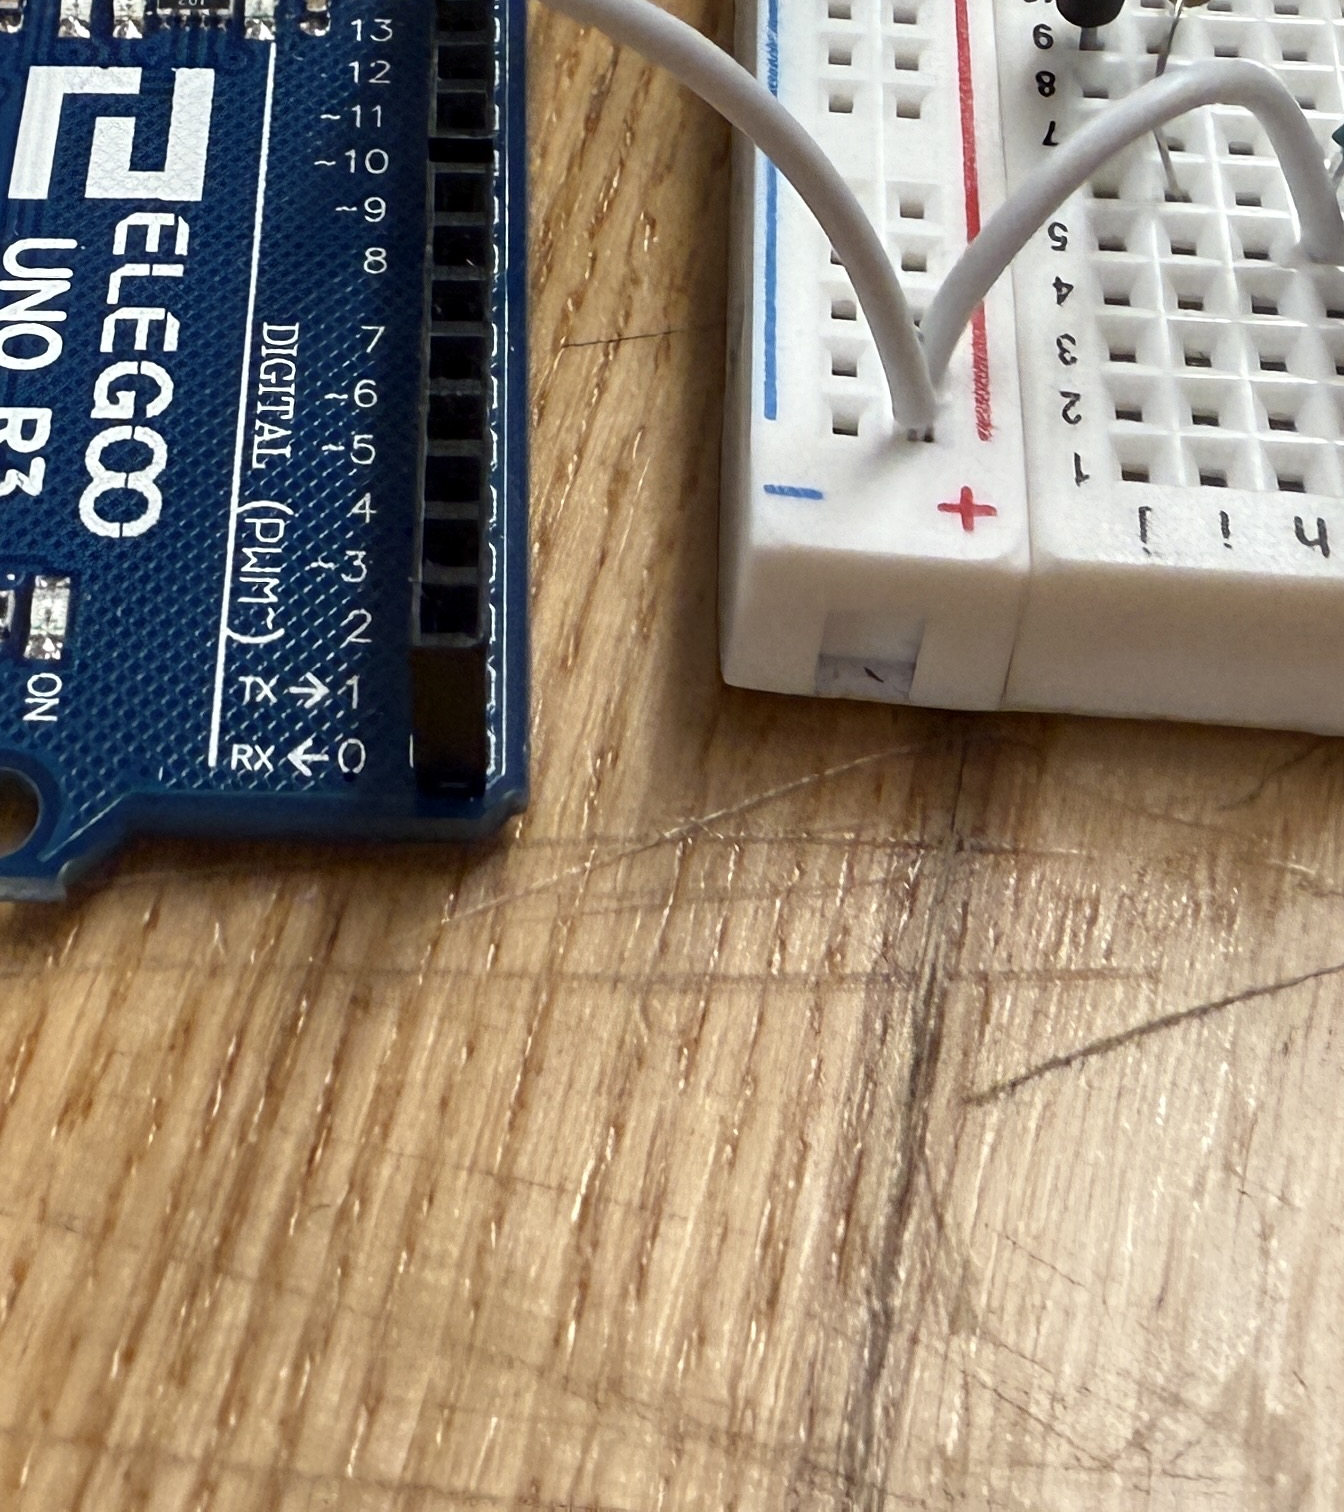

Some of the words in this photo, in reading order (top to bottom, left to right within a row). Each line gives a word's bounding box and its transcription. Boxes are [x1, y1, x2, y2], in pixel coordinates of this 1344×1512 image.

[350, 18, 393, 42] 13
[1033, 23, 1054, 49] 9
[349, 60, 391, 84] 12
[1035, 70, 1056, 97] 8
[1042, 120, 1059, 146] 7
[1047, 221, 1068, 251] 5
[363, 247, 388, 274] 8
[1052, 276, 1074, 306] 4
[361, 325, 386, 353] 7
[1056, 333, 1077, 366] 3
[79, 211, 190, 539] ELEGOO
[252, 322, 299, 468] DIGITAL
[1059, 389, 1083, 425] 2
[1073, 452, 1091, 487] 1
[352, 492, 377, 523] 4
[1138, 506, 1152, 555] j
[1220, 510, 1232, 548] i
[1294, 516, 1330, 558] h
[340, 609, 373, 643] 2
[22, 673, 62, 721] ON
[239, 675, 277, 704] TX
[342, 675, 360, 708] 1
[231, 744, 275, 771] RX
[337, 738, 366, 774] 0
